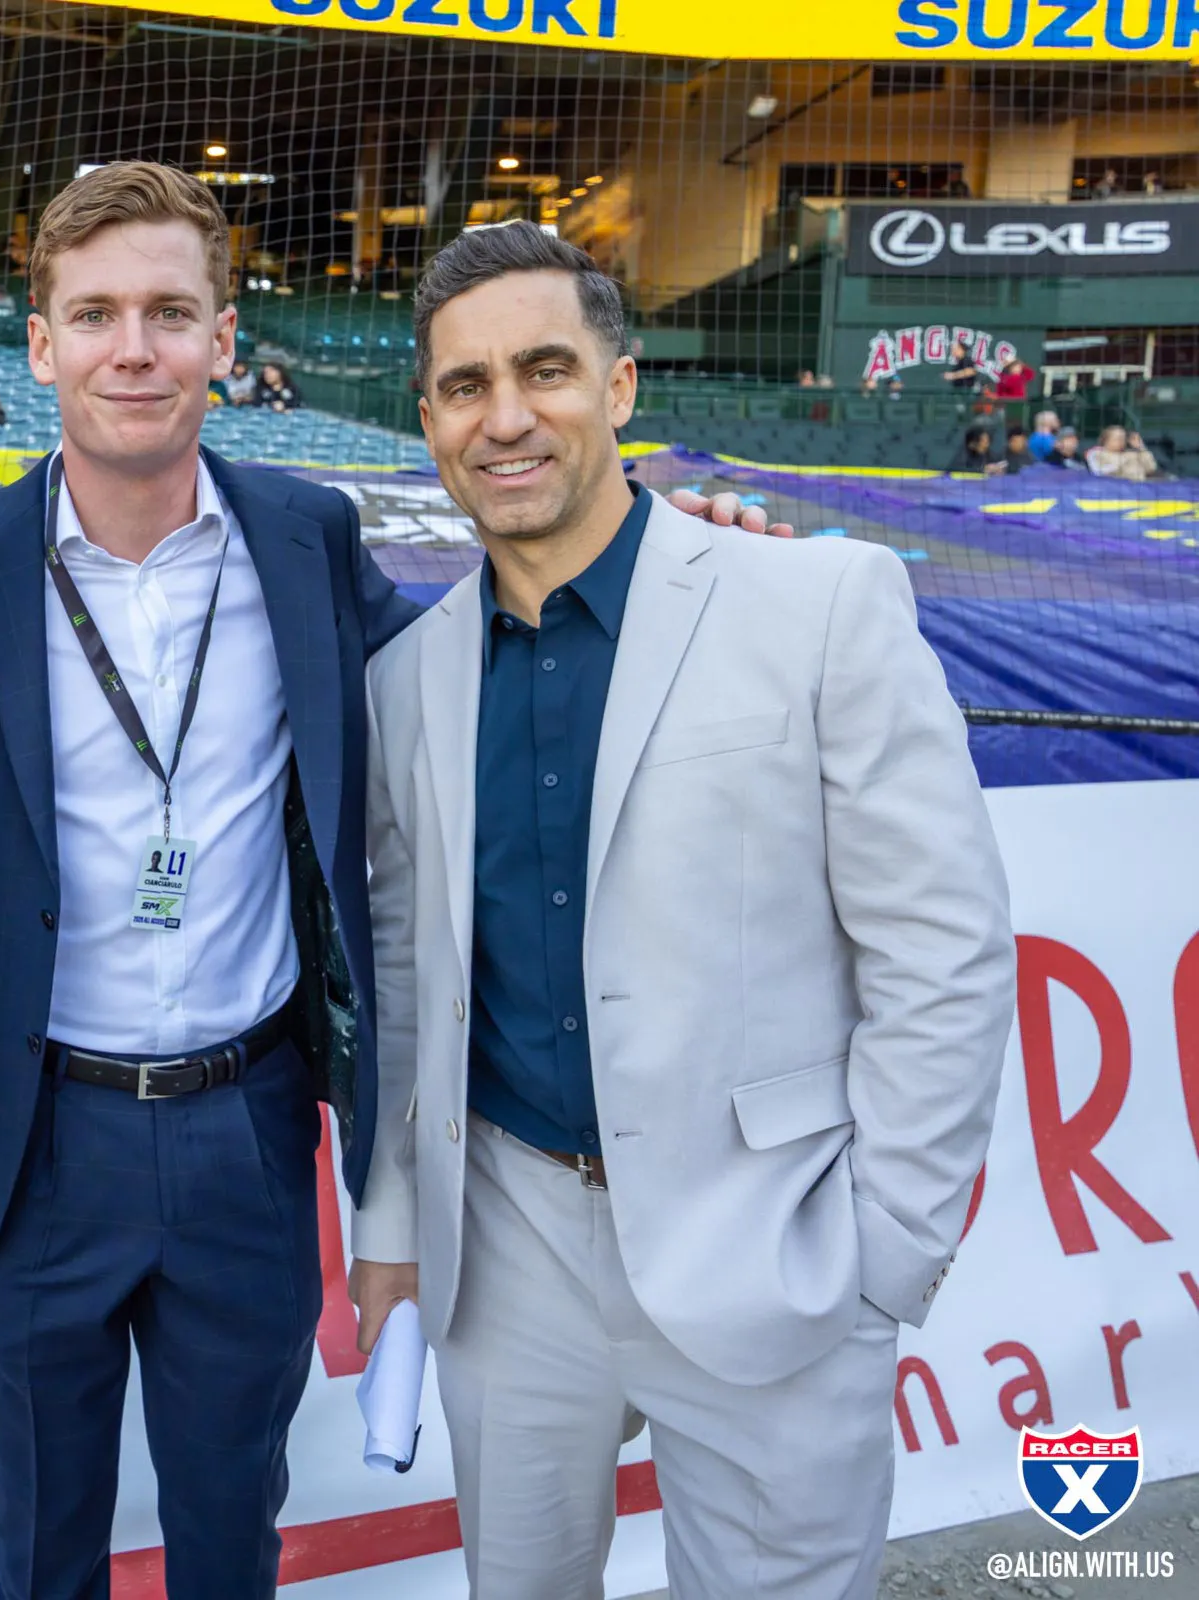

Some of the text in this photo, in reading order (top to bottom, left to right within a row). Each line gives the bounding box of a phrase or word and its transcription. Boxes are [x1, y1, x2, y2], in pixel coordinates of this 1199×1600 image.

[951, 220, 1171, 255] LEXUS
[167, 850, 186, 876] L1
[140, 897, 179, 916] SMX
